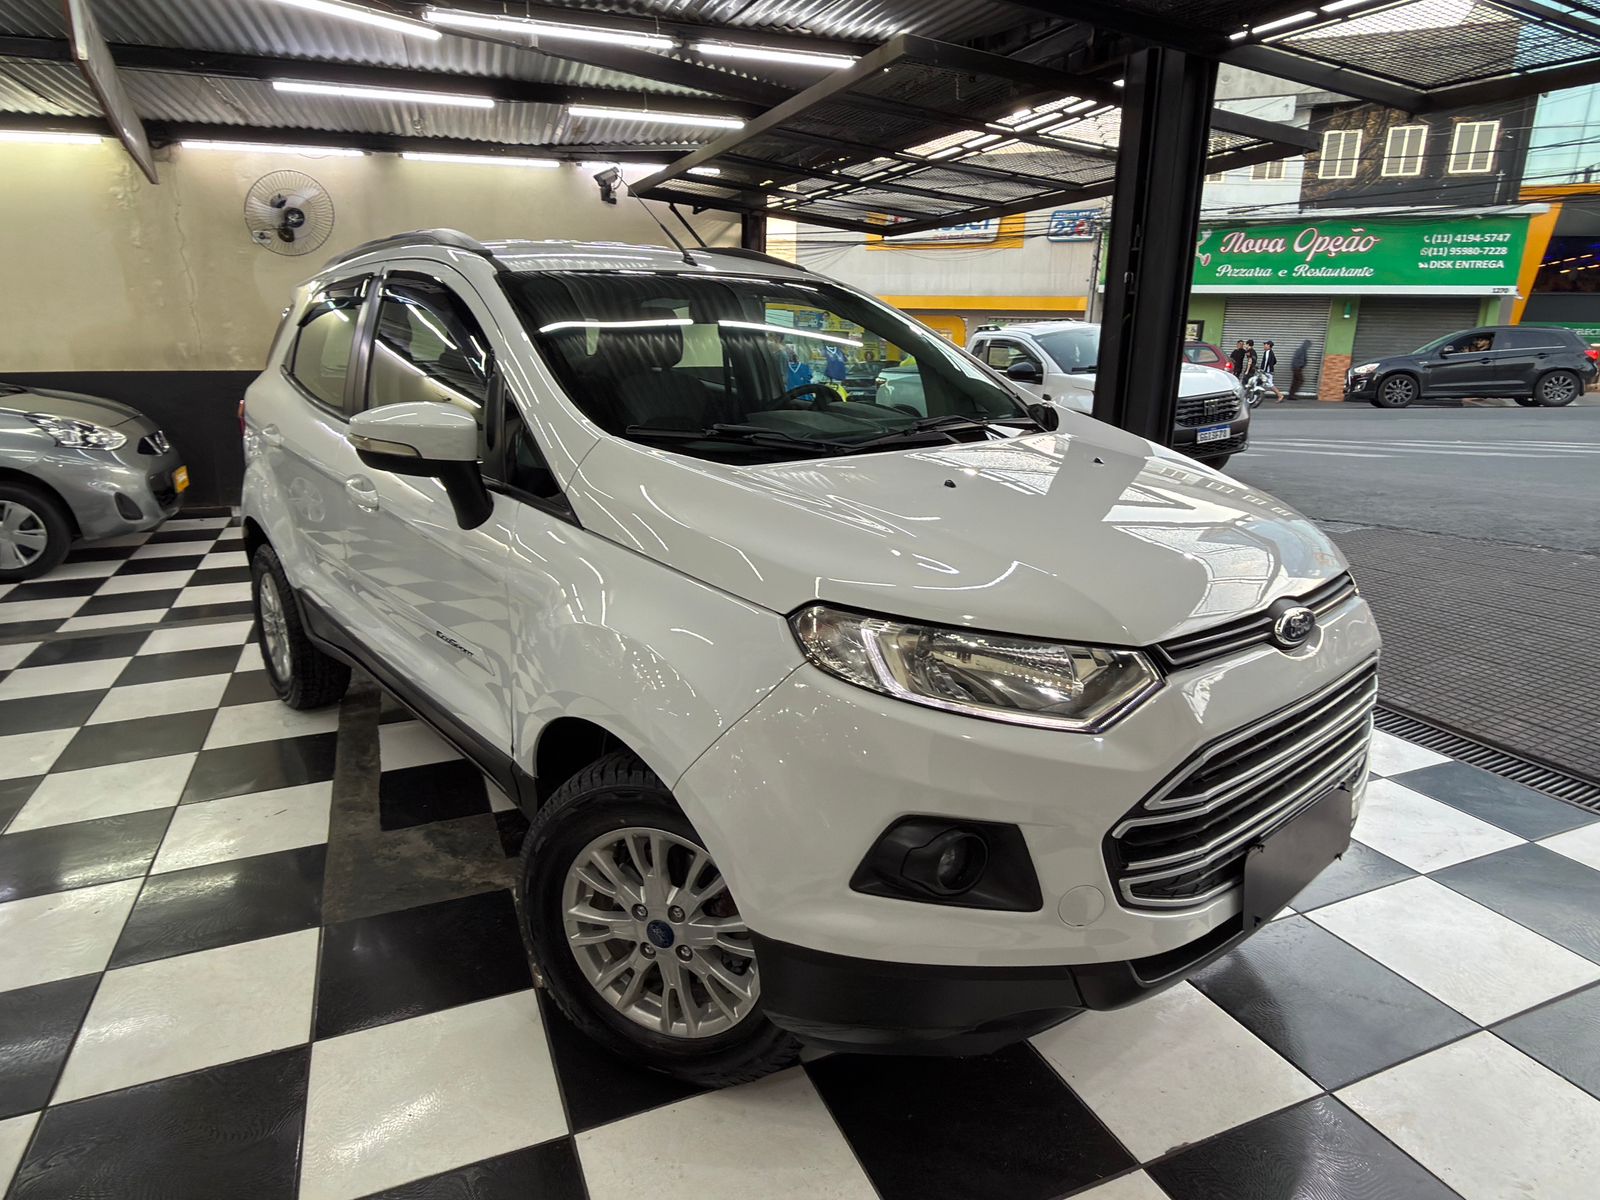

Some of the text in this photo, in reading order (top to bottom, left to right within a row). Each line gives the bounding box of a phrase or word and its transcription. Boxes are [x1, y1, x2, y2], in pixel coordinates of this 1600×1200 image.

[1431, 233, 1511, 244] (11) 4194-5747
[1220, 227, 1381, 262] Nova Opção
[1428, 246, 1448, 257] (11)
[1429, 260, 1504, 269] DISK ENTREGA
[1215, 263, 1375, 278] Pizzaria e Restaurante
